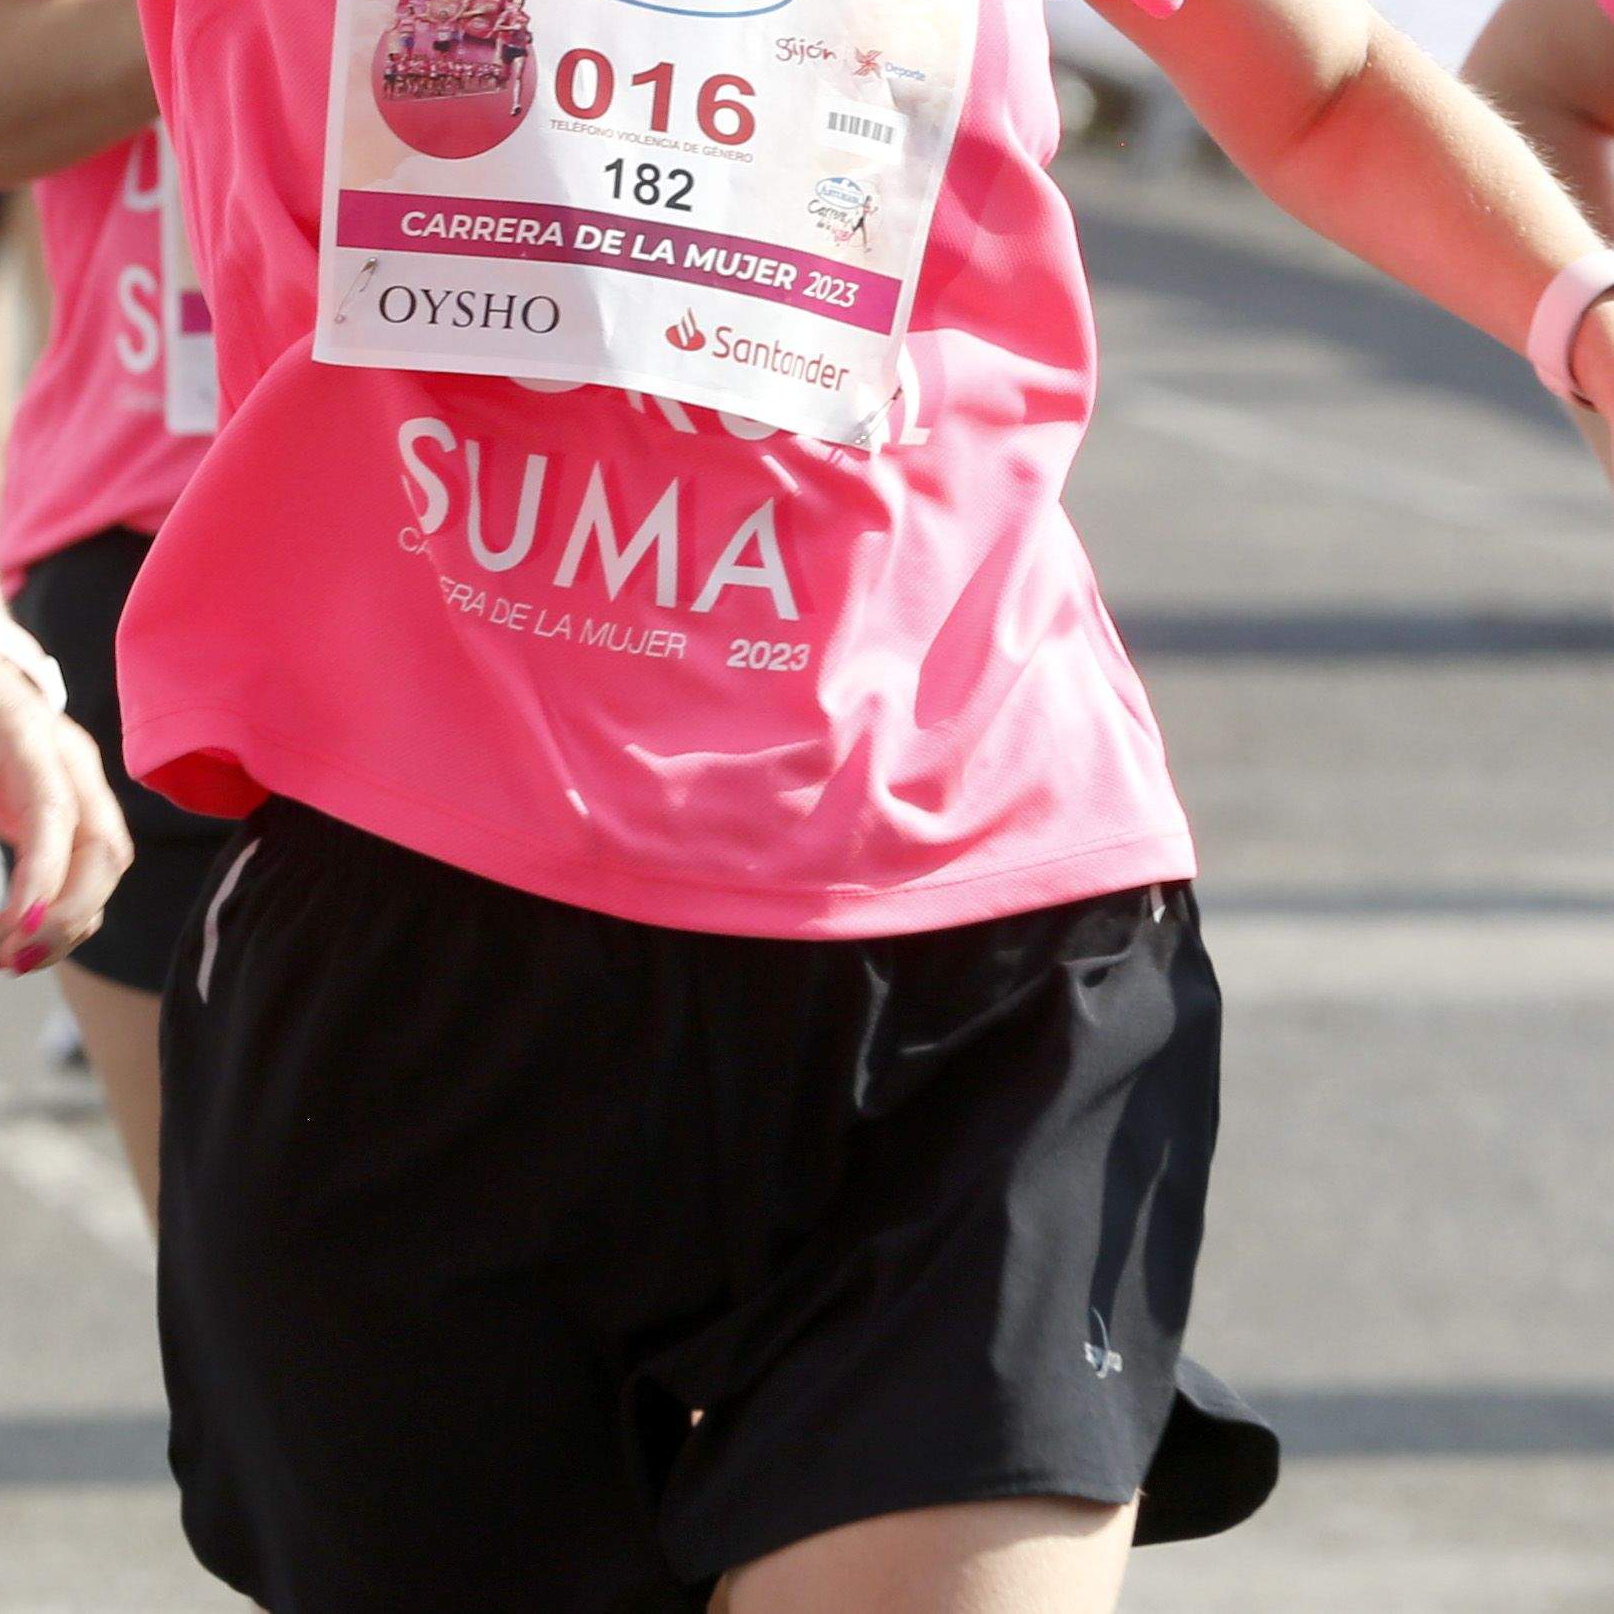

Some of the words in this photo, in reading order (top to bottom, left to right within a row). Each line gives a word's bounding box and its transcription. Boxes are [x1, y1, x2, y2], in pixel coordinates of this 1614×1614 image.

[553, 47, 757, 146] 016
[550, 119, 614, 138] TELÉFONO
[617, 130, 681, 151] VIOLENCIA
[683, 141, 700, 155] DE
[603, 157, 695, 213] 182
[400, 210, 564, 247] CARRERA
[573, 223, 623, 257] DE
[631, 233, 677, 265] LA
[683, 243, 799, 292] MUJER
[801, 270, 861, 309] 2023
[378, 285, 561, 335] OYSHO
[712, 325, 850, 392] Santander
[397, 416, 801, 622] SUMA
[490, 598, 533, 631] DE
[534, 609, 572, 641] LA
[579, 618, 688, 660] MUJER
[726, 639, 812, 672] 2023
